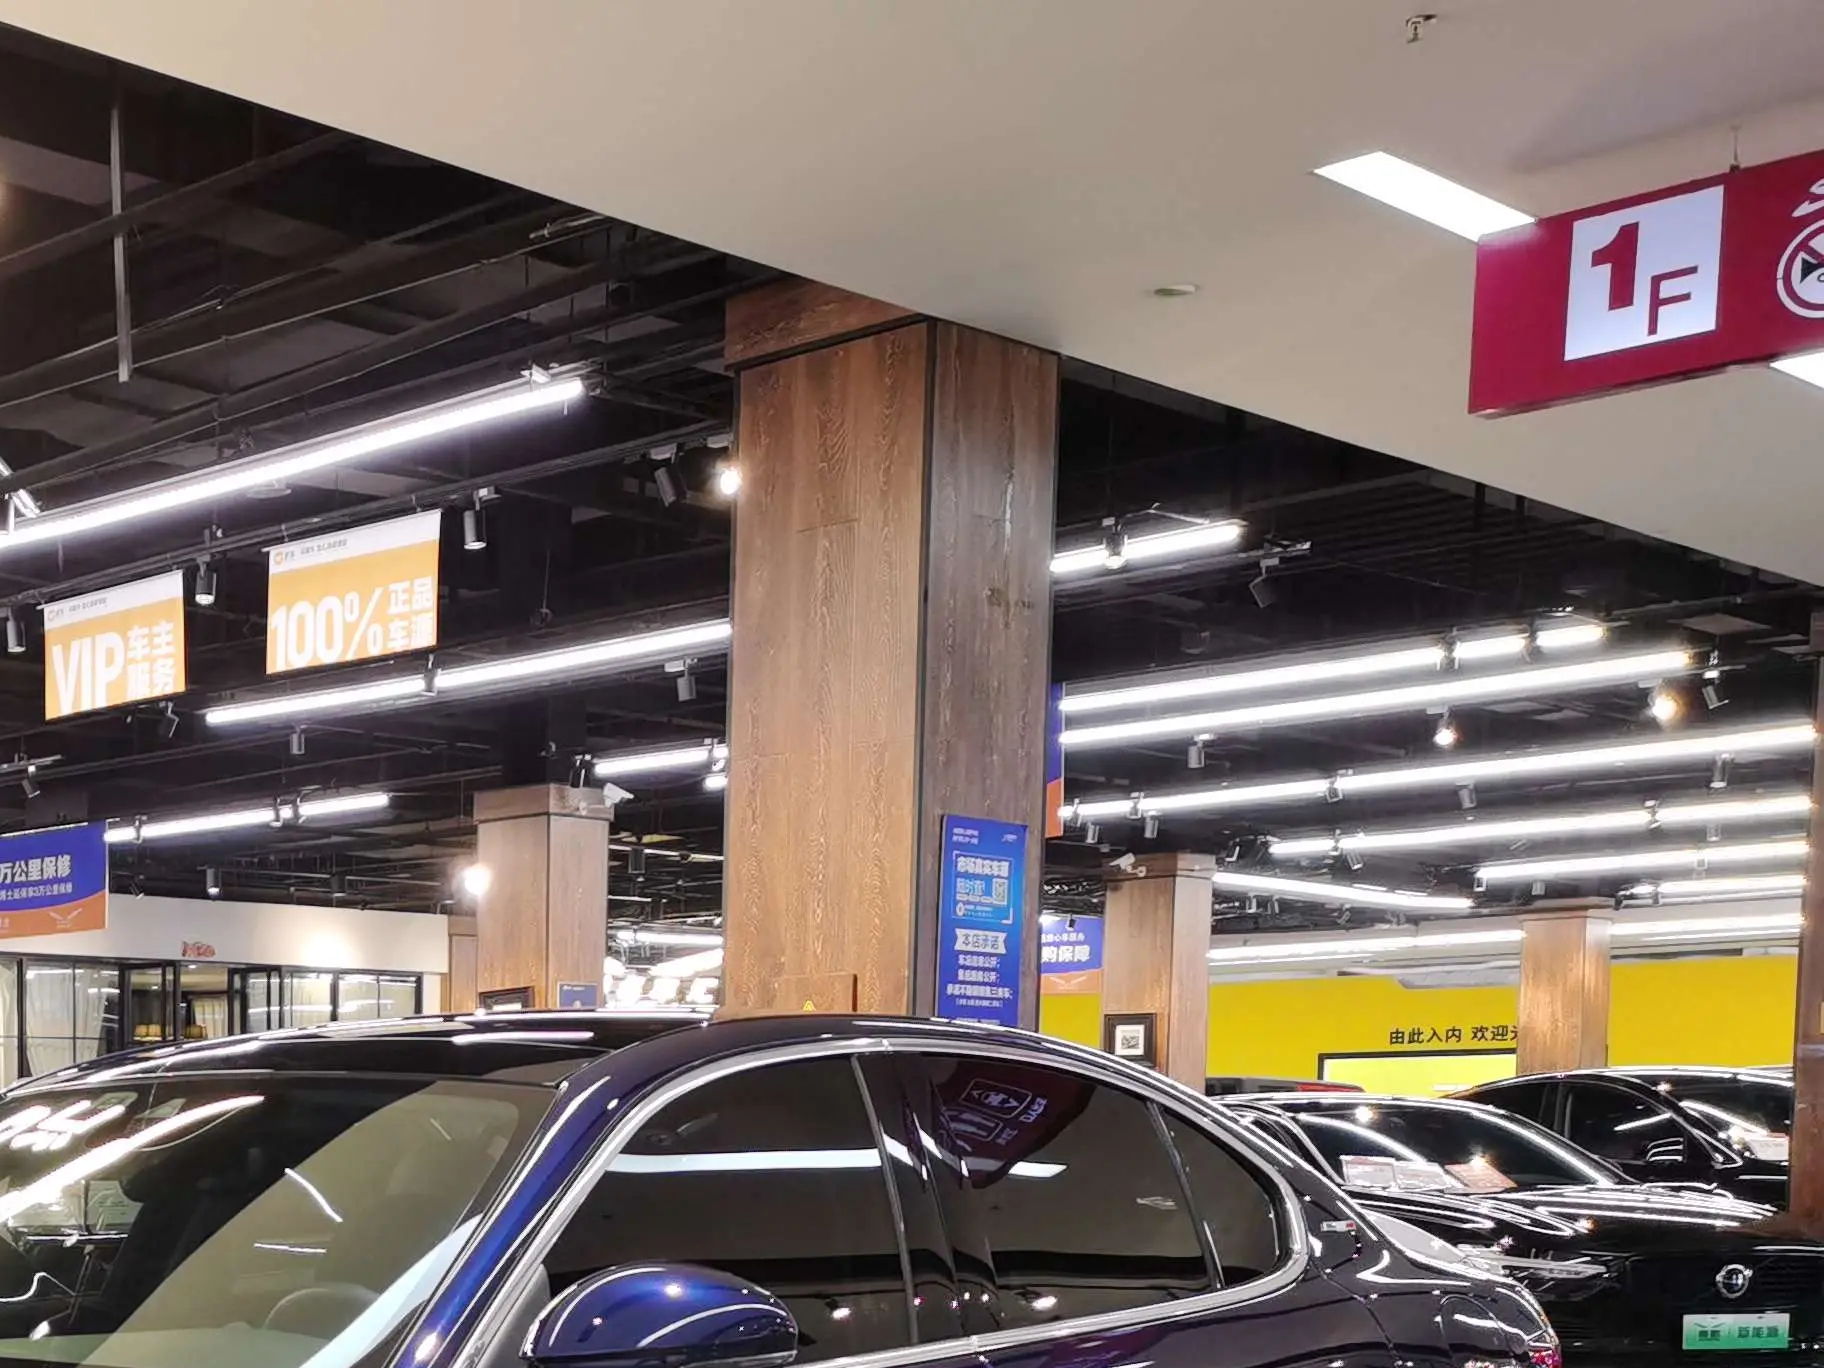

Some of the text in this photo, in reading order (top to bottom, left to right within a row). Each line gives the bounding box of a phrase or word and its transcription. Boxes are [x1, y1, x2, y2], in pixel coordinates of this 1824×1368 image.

[388, 576, 434, 615] 正品
[127, 620, 175, 661] 车主
[270, 587, 384, 671] 100%
[52, 631, 125, 716] VIP
[127, 658, 175, 700] 服务
[1389, 1027, 1462, 1045] 由此入内
